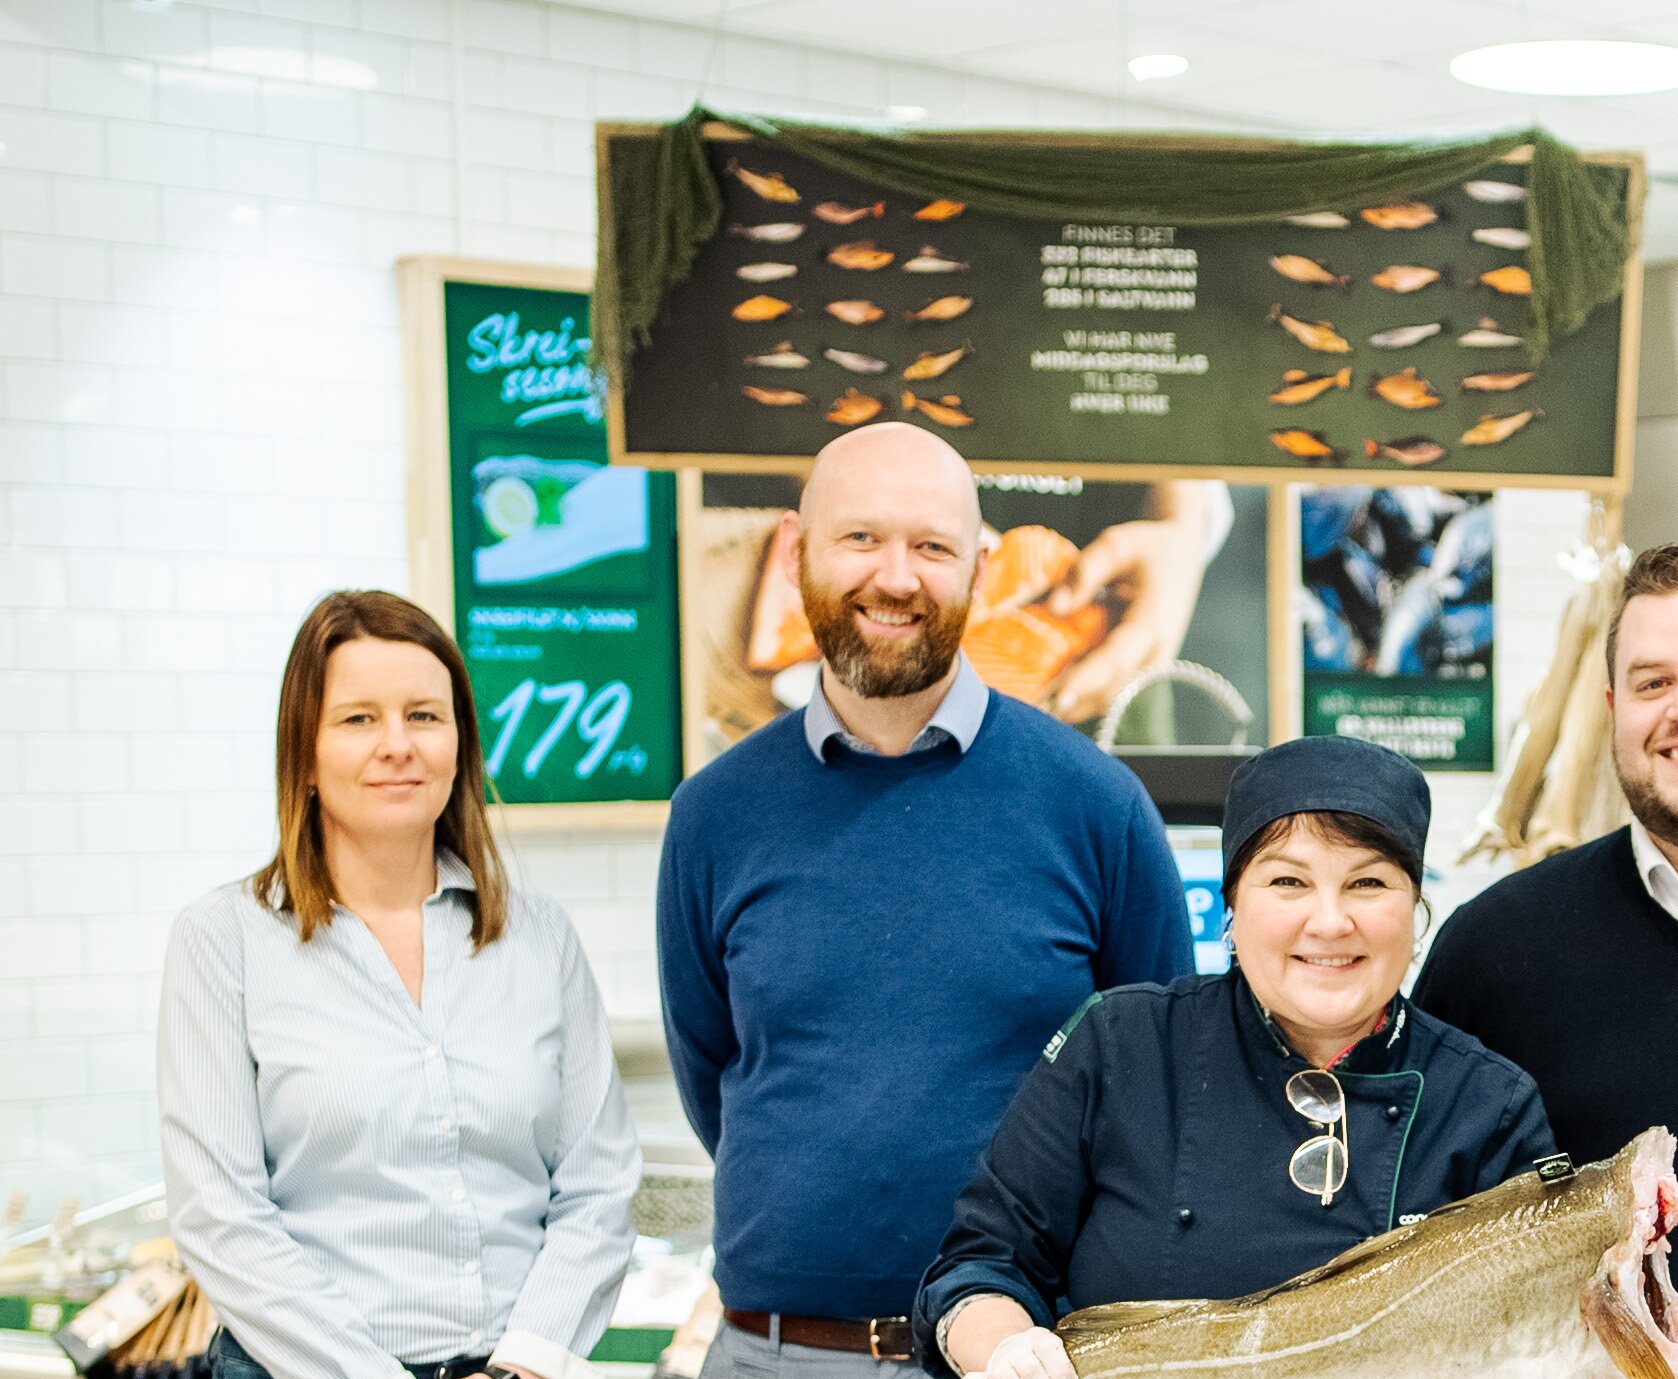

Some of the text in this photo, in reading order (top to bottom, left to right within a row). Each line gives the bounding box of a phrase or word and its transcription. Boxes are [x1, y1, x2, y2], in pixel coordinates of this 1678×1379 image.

[1061, 224, 1177, 247] FINNES DET
[1063, 330, 1086, 350] VI
[487, 677, 633, 779] 179
